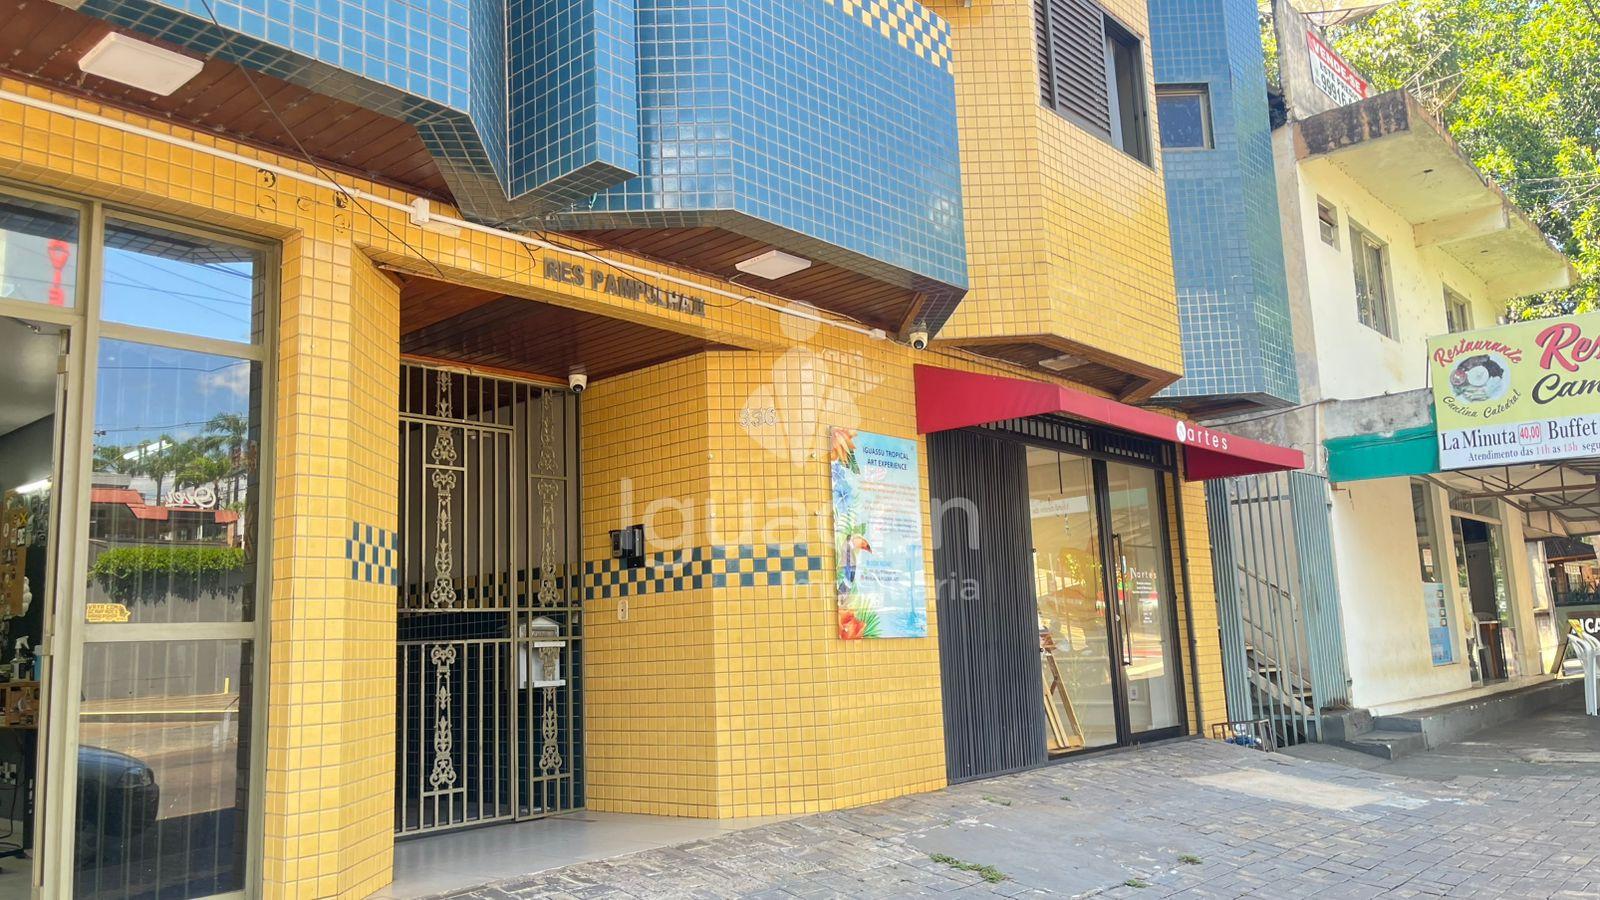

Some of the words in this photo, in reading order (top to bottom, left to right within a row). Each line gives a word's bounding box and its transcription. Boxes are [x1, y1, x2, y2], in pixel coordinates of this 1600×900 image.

[1313, 39, 1362, 95] VENDE-SE
[1321, 74, 1352, 105] 99916
[543, 256, 585, 286] RES
[591, 269, 693, 315] PAMPULHA
[1434, 338, 1523, 367] Restaurante
[1443, 396, 1478, 418] Cantina
[1483, 389, 1521, 418] Catedral
[1441, 432, 1459, 450] La
[1462, 429, 1516, 449] Minuta
[1547, 417, 1598, 440] Buffet
[863, 446, 885, 457] IGUASSU
[886, 450, 909, 460] TROPICAL
[878, 460, 908, 471] EXPERIENCE
[1468, 450, 1518, 462] Atendimento
[1520, 446, 1534, 456] das
